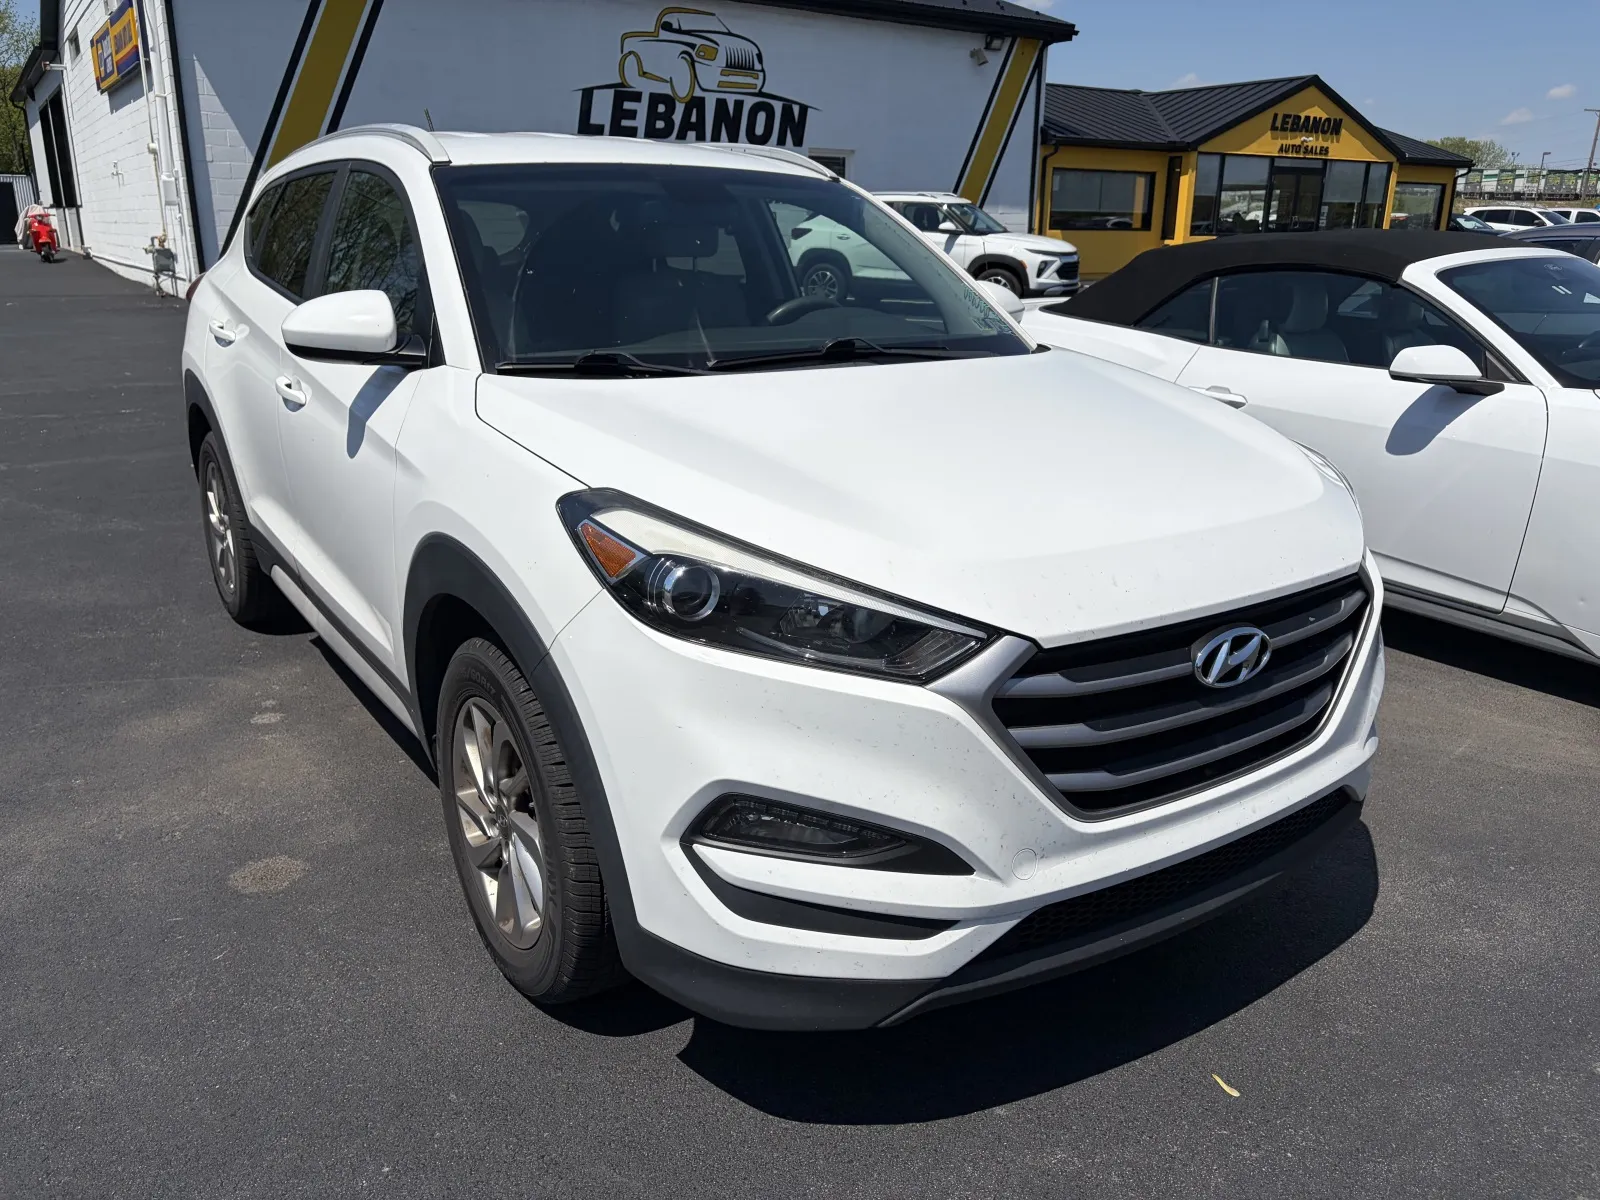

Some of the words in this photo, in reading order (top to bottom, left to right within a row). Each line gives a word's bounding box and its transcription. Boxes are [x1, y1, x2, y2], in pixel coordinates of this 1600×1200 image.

[577, 88, 808, 147] LEBANON
[1270, 112, 1343, 135] LEBANON
[1278, 143, 1301, 154] AUTO
[1302, 145, 1329, 155] SALES
